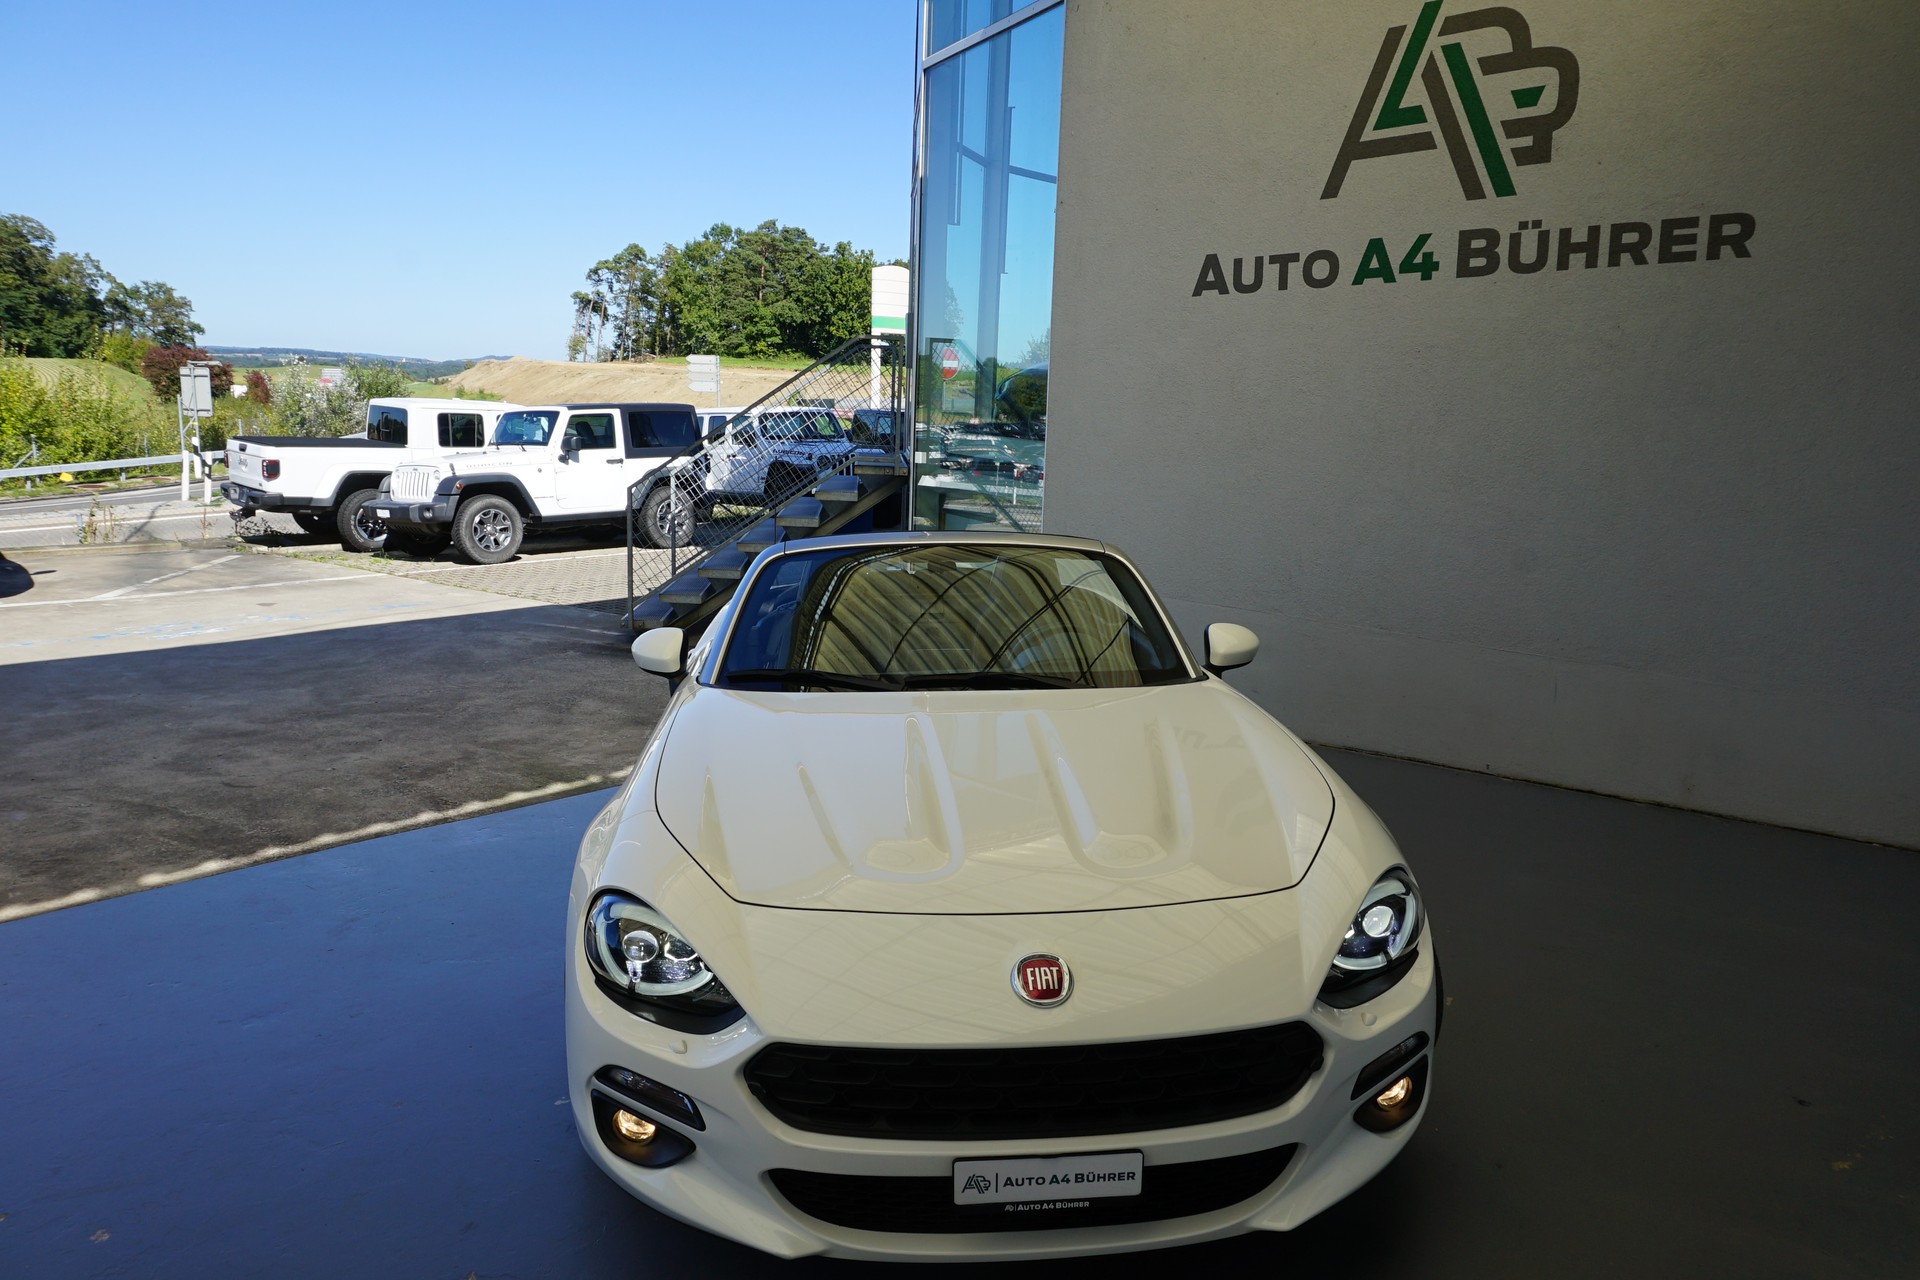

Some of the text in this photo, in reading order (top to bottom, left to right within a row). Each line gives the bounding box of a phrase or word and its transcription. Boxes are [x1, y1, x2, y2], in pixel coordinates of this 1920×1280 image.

[1191, 212, 1756, 297] AUTO A4 BÜHRER
[1026, 966, 1059, 991] FIAT
[1003, 1176, 1046, 1188] AUTO
[1049, 1174, 1071, 1186] A4
[1074, 1171, 1136, 1184] BÜHRER
[1042, 1202, 1054, 1210] A4
